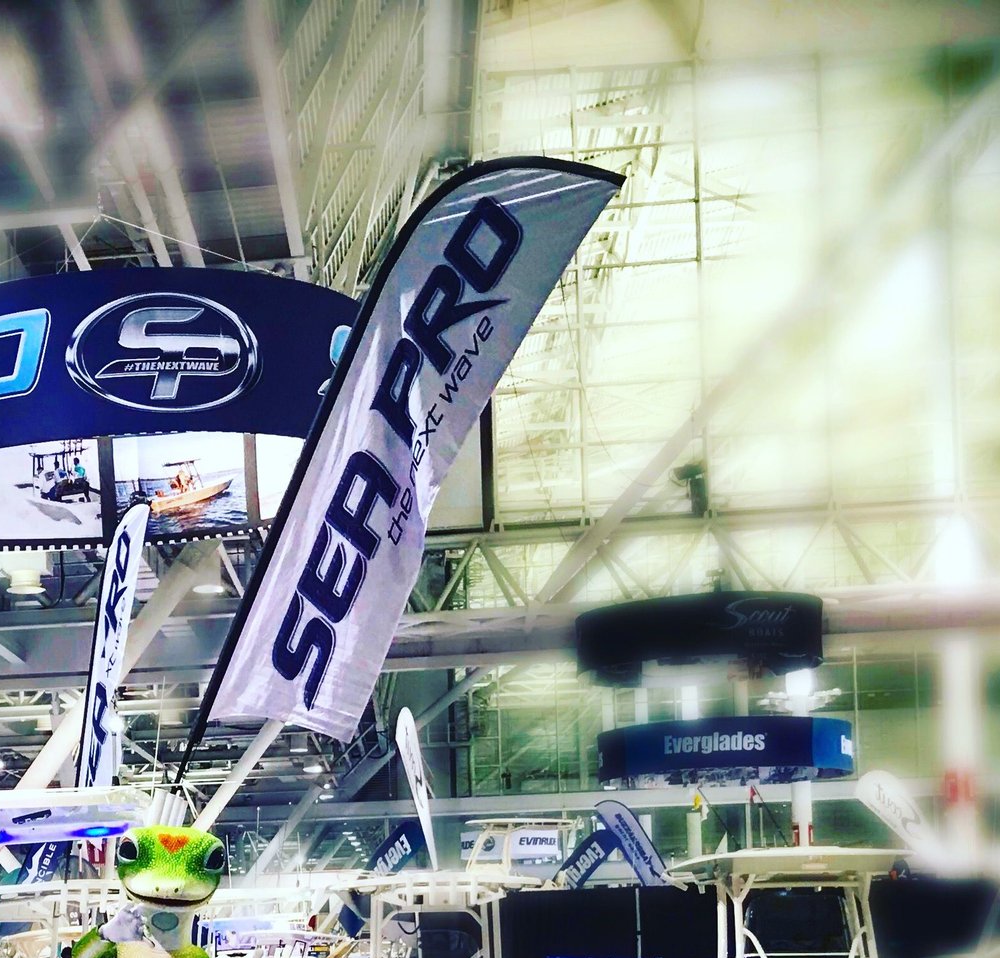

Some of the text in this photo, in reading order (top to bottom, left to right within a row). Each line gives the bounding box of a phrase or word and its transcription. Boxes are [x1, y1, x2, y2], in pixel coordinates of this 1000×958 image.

[124, 361, 220, 372] #THENEXTWAVE
[387, 315, 494, 546] the next wave
[272, 196, 524, 711] SEA PRO
[664, 731, 766, 755] Everglades
[518, 836, 557, 847] EVINRUDE
